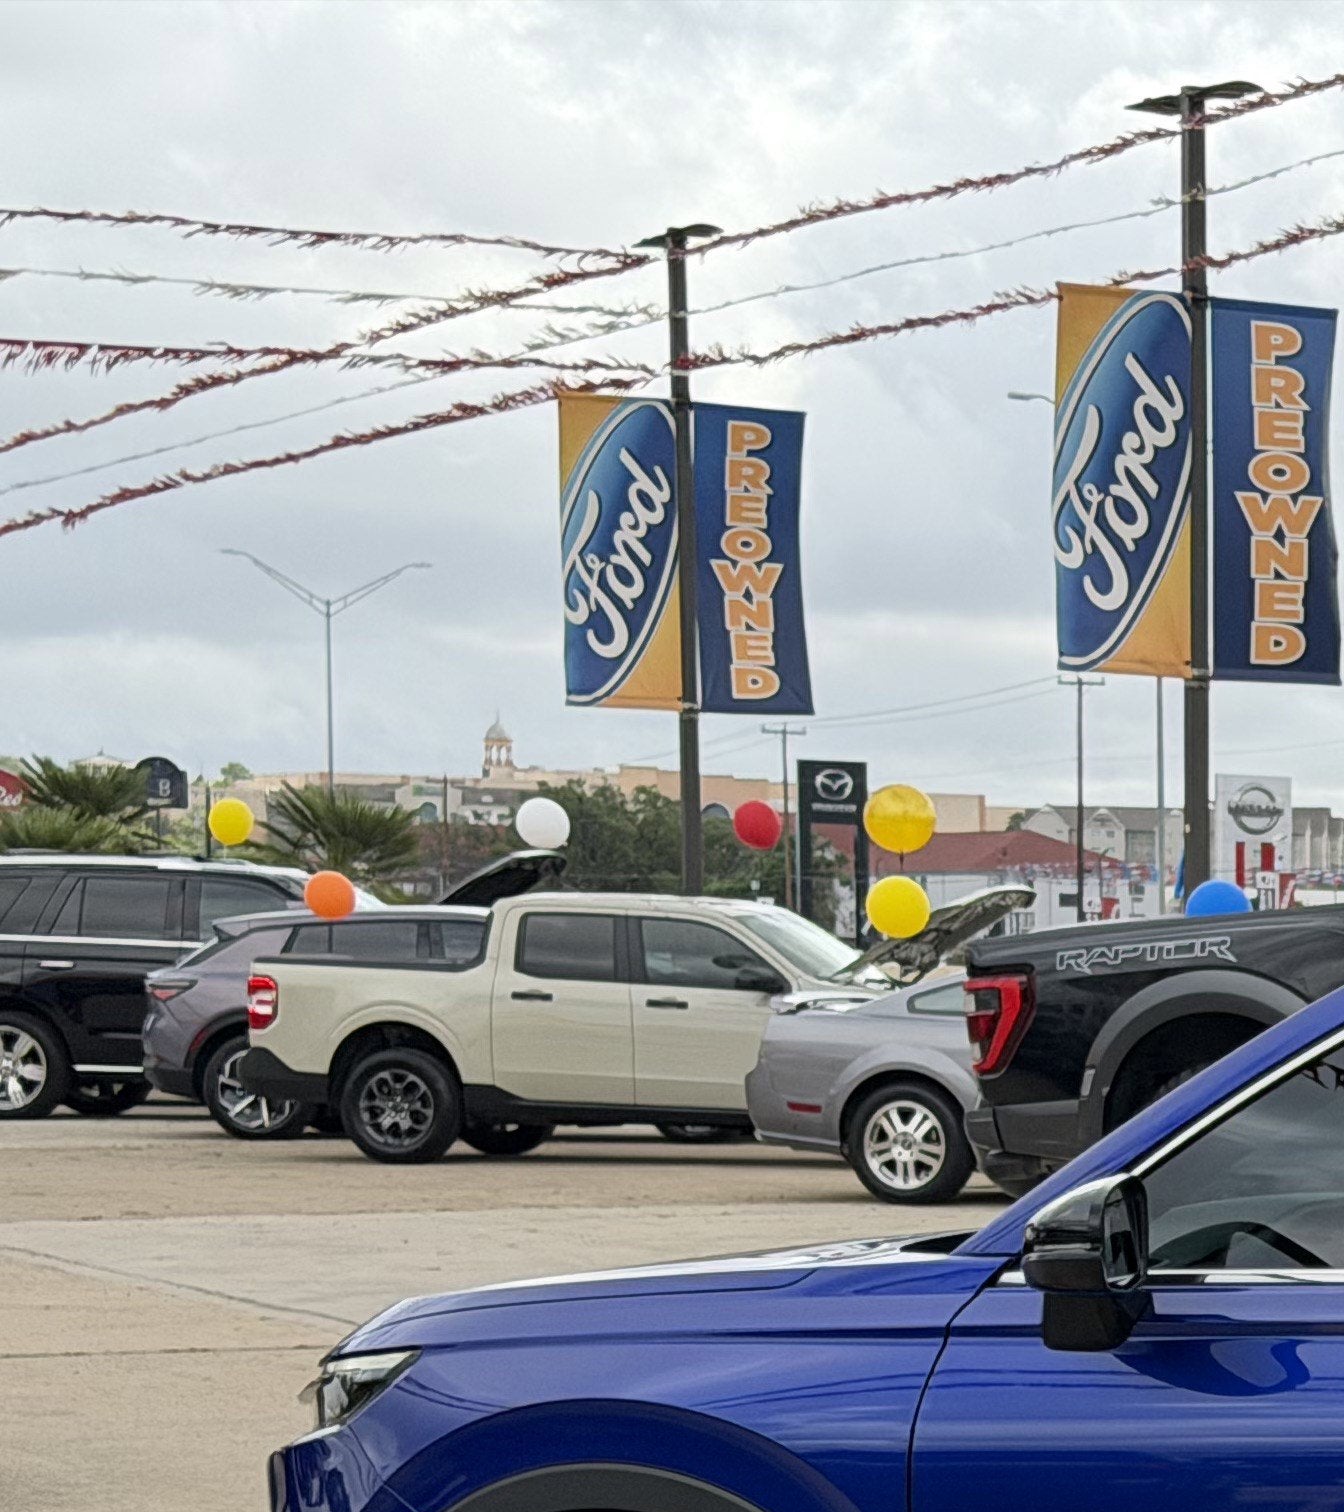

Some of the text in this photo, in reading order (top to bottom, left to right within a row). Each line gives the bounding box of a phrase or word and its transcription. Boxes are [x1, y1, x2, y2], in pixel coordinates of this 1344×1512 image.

[565, 446, 671, 659] Ford
[708, 419, 784, 700] PREOWNED
[1054, 351, 1185, 612] Ford
[1234, 319, 1324, 666] PREOWNED
[1056, 935, 1239, 976] RAPTOR
